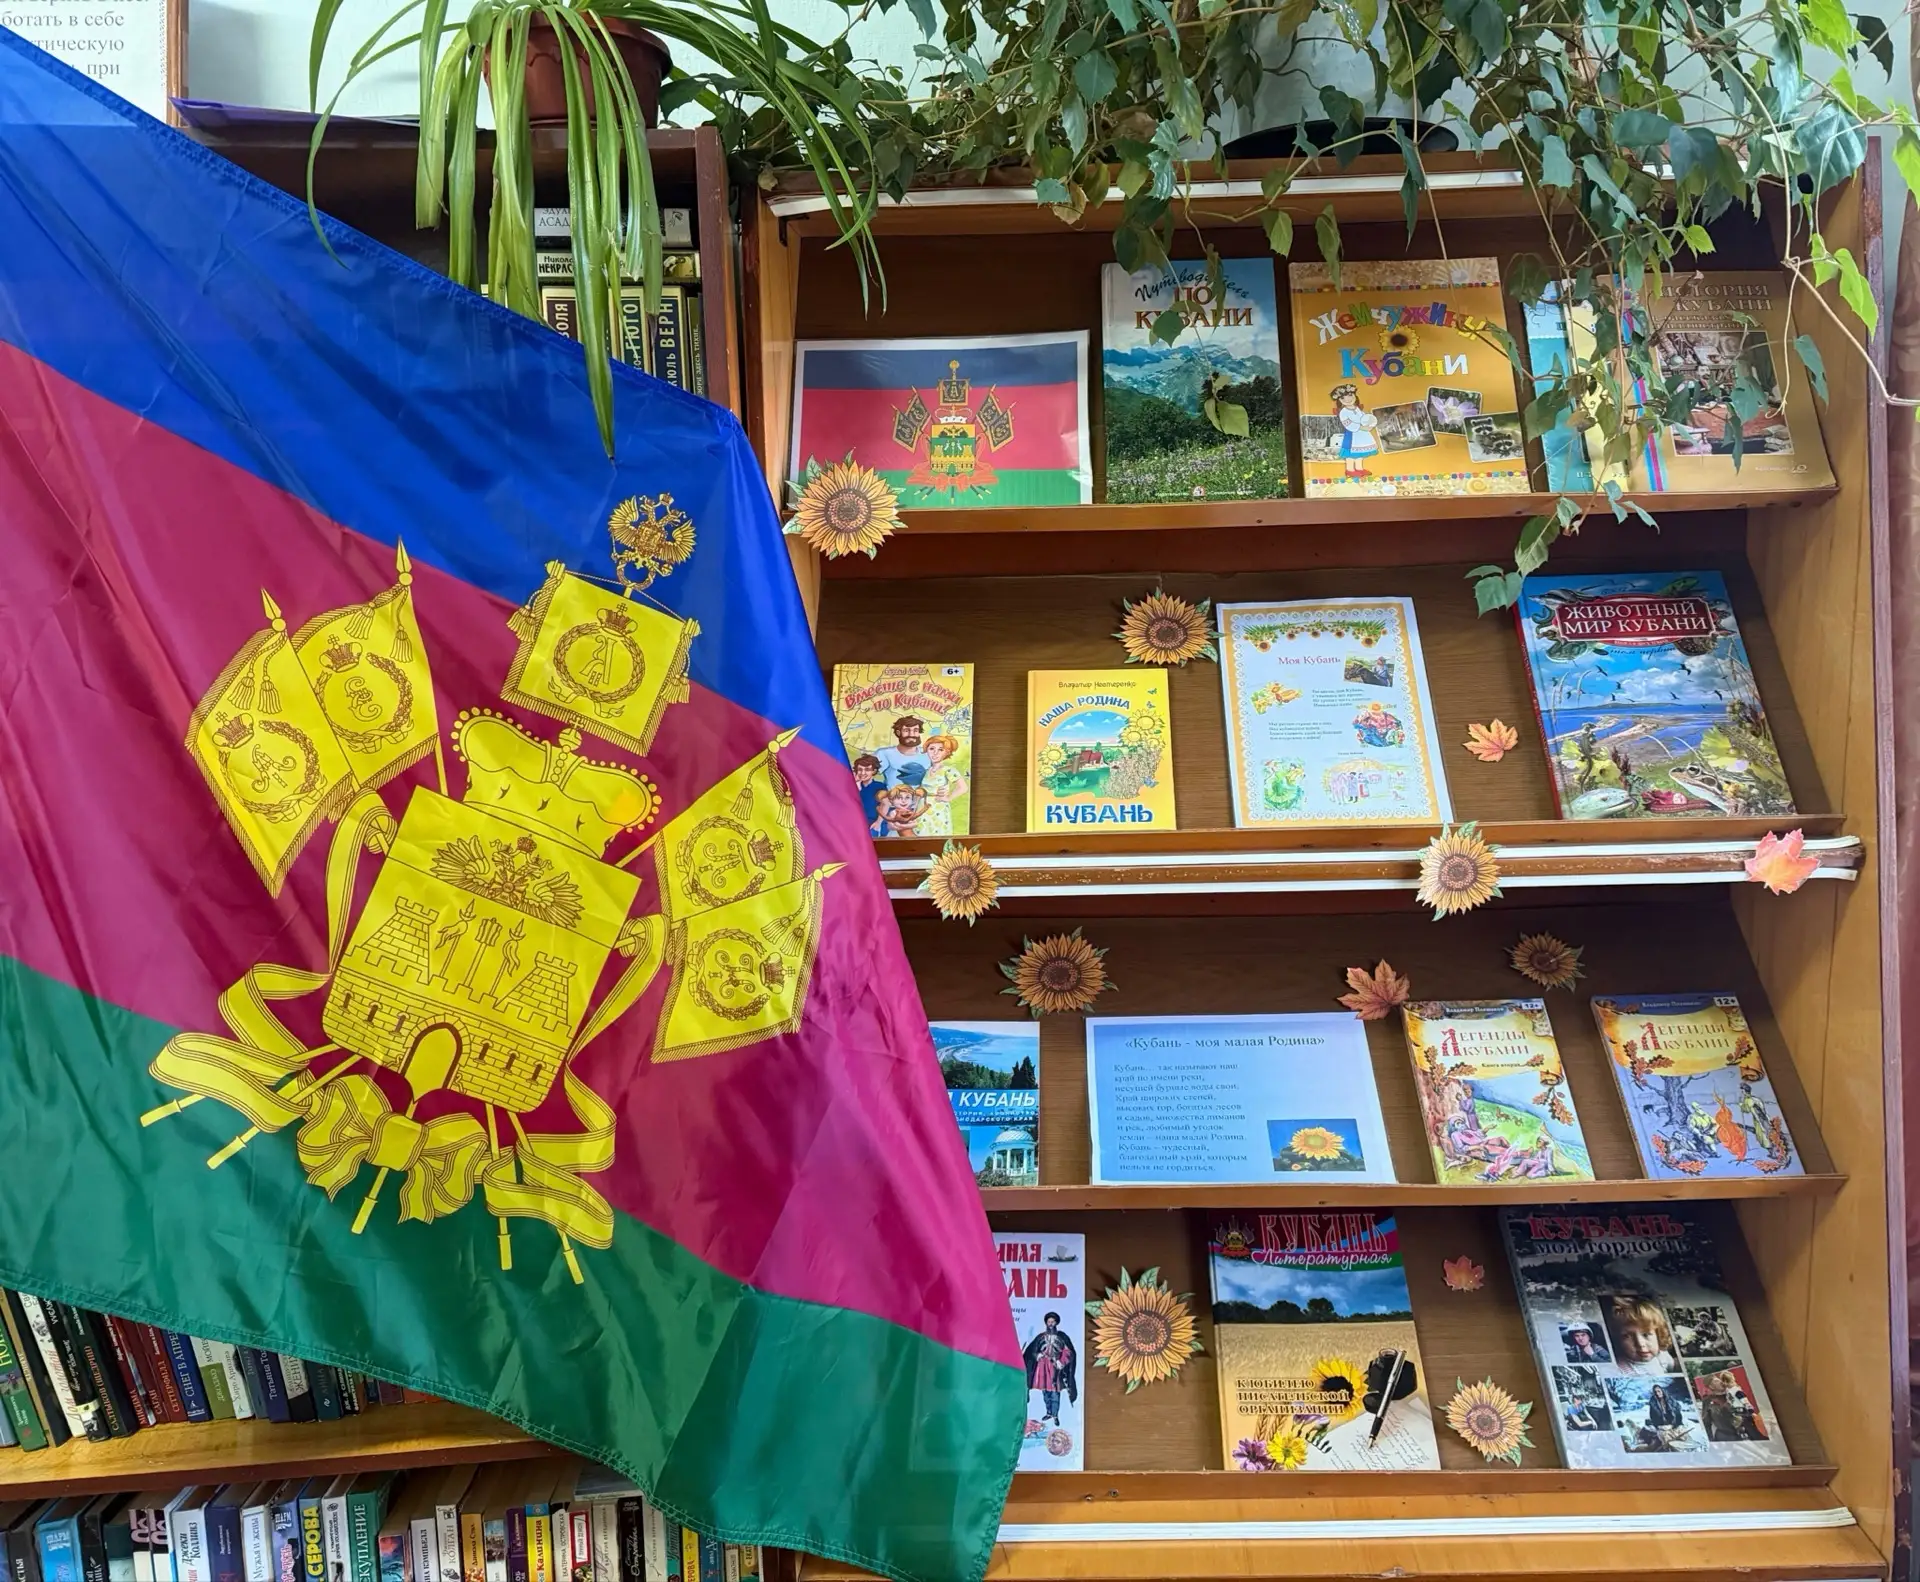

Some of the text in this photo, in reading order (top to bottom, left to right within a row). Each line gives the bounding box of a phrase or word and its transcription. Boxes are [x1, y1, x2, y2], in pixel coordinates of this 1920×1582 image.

[69, 17, 78, 26] в
[84, 11, 124, 27] себе
[87, 64, 120, 79] при
[1173, 286, 1214, 305] ПО
[623, 303, 641, 350] ГЮГО
[658, 303, 676, 348] ВЕРН
[1338, 348, 1469, 385] Кубани
[1565, 601, 1698, 620] ЖИВОТНЫЙ
[1564, 616, 1709, 635] МИР КУБАНИ
[1278, 655, 1341, 666] Моя Кубань
[844, 680, 964, 709] Вместе с нами
[872, 692, 951, 715] по Кубани!
[1038, 695, 1131, 727] НАША РОДИНА
[1046, 803, 1154, 824] КУБАНЬ
[1717, 997, 1736, 1005] 12+
[1125, 1037, 1181, 1051] «Кубань
[1195, 1040, 1220, 1048] моя
[1225, 1038, 1264, 1047] малая
[1268, 1035, 1325, 1048] Родина»
[1463, 1045, 1530, 1056] КУБАНИ
[1663, 1038, 1730, 1050] КУБАНИ
[959, 1092, 1036, 1107] КУБАНЬ
[1258, 1213, 1388, 1253] КУБАНЬ
[1528, 1214, 1685, 1240] КУБАНЬ
[1251, 1249, 1393, 1271] Литературная
[1000, 1268, 1068, 1298] АНЬ
[177, 1362, 187, 1370] В
[180, 1371, 195, 1397] СНЕГ
[263, 1363, 278, 1400] Татьяна
[1237, 1379, 1246, 1388] К
[180, 1532, 193, 1566] Джеки
[188, 1521, 202, 1560] Коллинз
[303, 1506, 324, 1576] СЕРОВА
[448, 1525, 456, 1564] КОЛГАН
[535, 1519, 545, 1571] Калинина
[253, 1549, 265, 1580] Мужья
